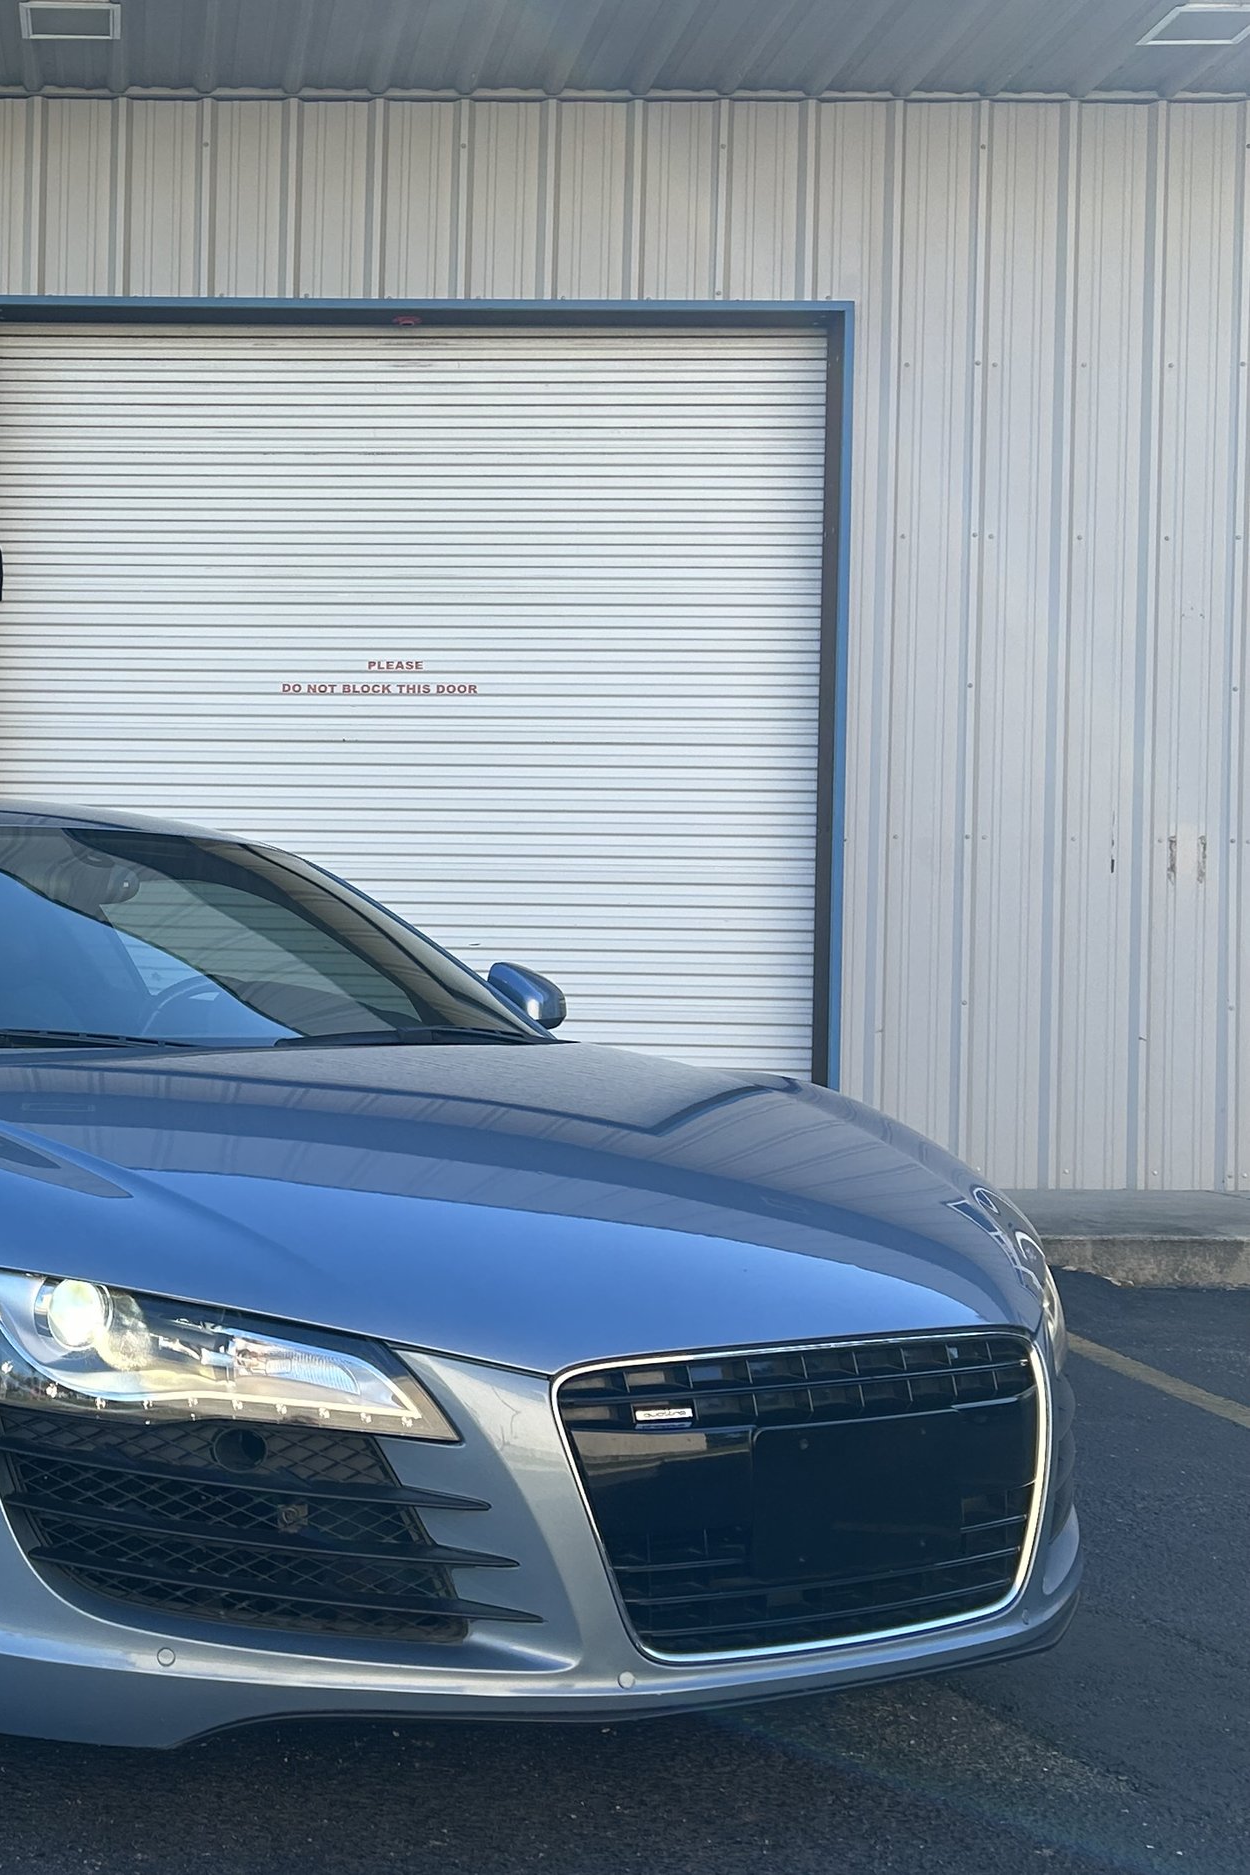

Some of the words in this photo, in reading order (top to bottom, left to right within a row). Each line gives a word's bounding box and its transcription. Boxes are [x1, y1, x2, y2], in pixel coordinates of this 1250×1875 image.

[367, 661, 424, 670] PLEASE
[282, 683, 302, 693] DO
[306, 684, 337, 693] NOT
[342, 684, 392, 694] BLOCK
[397, 684, 431, 694] THIS
[436, 684, 478, 694] DOOR
